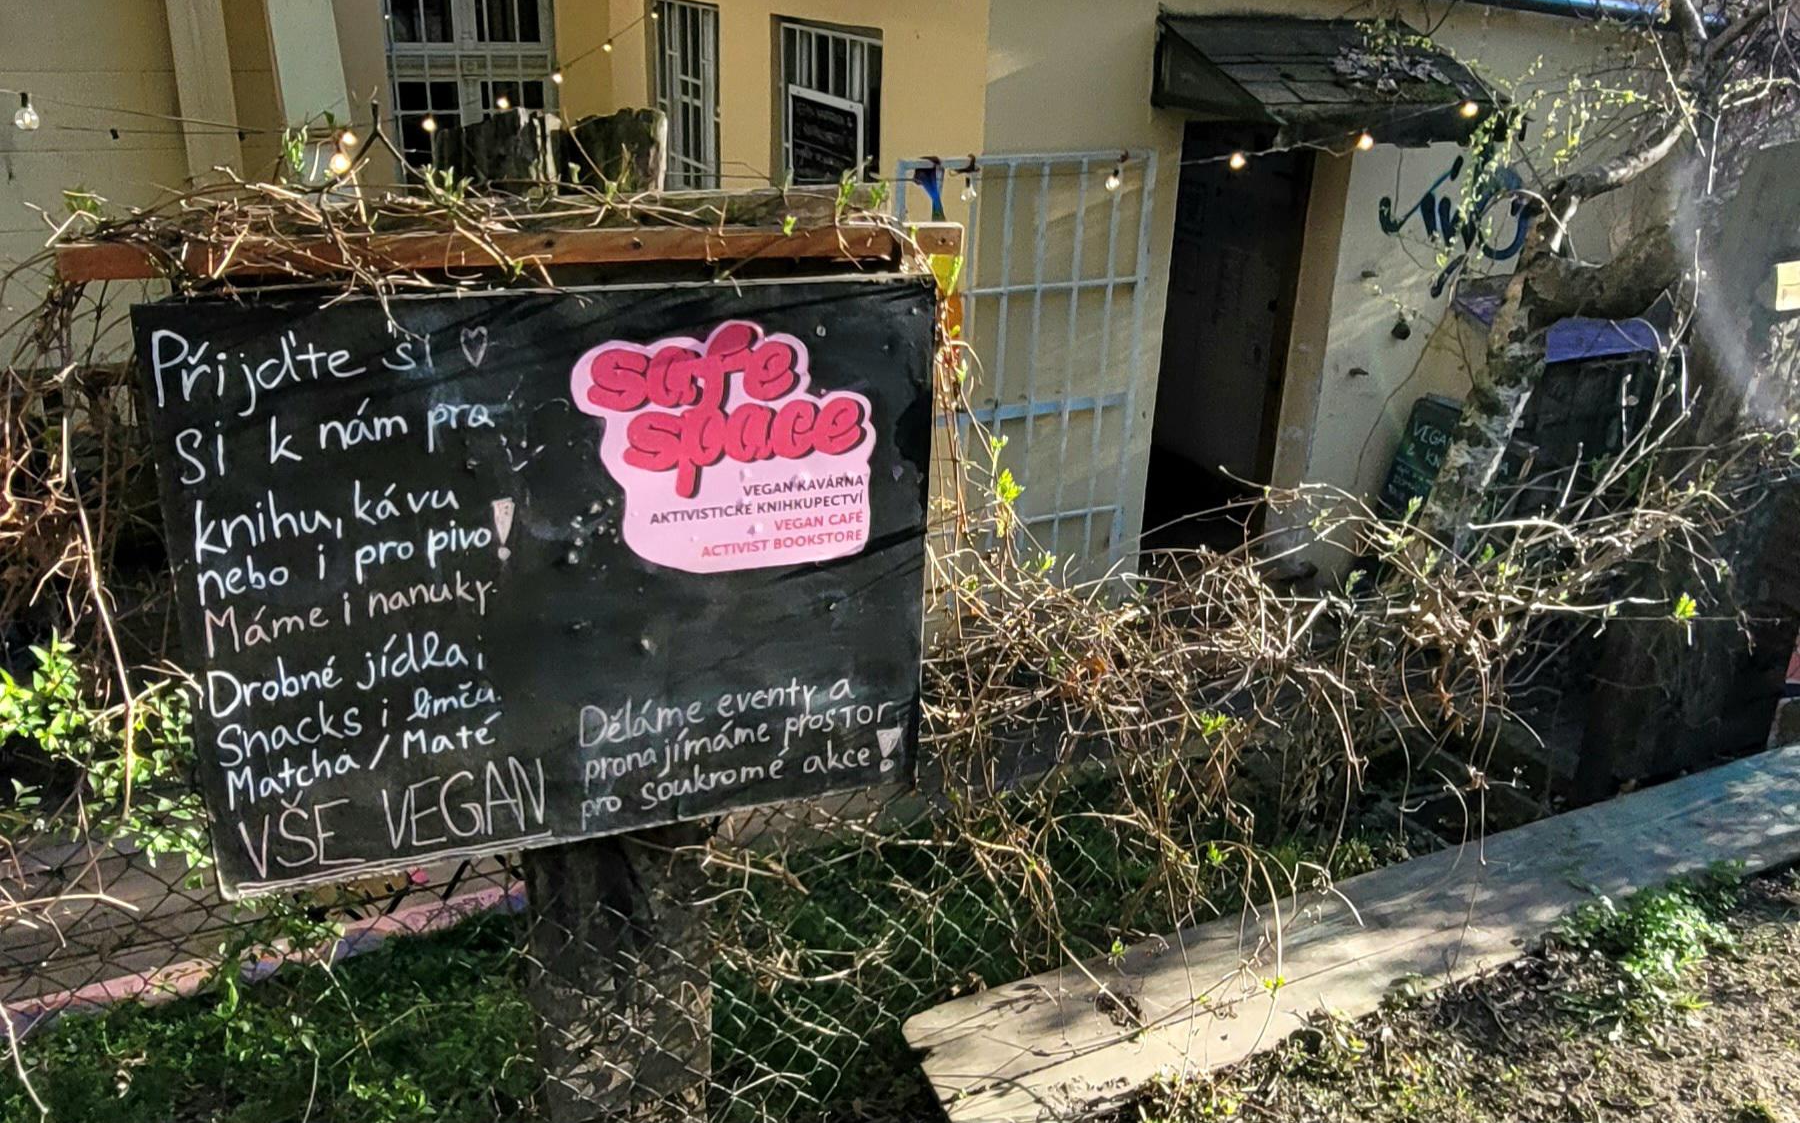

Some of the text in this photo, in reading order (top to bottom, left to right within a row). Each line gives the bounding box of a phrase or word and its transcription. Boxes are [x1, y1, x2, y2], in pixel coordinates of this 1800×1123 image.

[319, 398, 409, 450] nám
[623, 396, 867, 499] space
[354, 479, 459, 526] kávu
[743, 471, 864, 497] VEGAN KAVÁRNA
[756, 490, 864, 515] KNIHKUPECTVÍ
[701, 529, 863, 558] ACTIVIST BOOKSTORE
[774, 510, 863, 531] VEGAN CAFÉ
[197, 555, 289, 606] nebo
[318, 544, 326, 579] i
[354, 540, 414, 584] pro
[204, 605, 329, 658] Máme
[343, 592, 351, 626] i
[207, 655, 343, 719] Drobné
[356, 631, 469, 692] jídla
[216, 701, 363, 767] Snacks
[381, 698, 389, 728] i
[579, 694, 704, 749] Děláme
[717, 677, 817, 718] eventy
[226, 750, 360, 811] Matcha
[402, 711, 502, 760] Maté
[580, 796, 622, 831] pro
[640, 744, 789, 812] soukromé
[585, 721, 771, 793] pronajímáme
[238, 757, 544, 879] VŠE VEGAN
